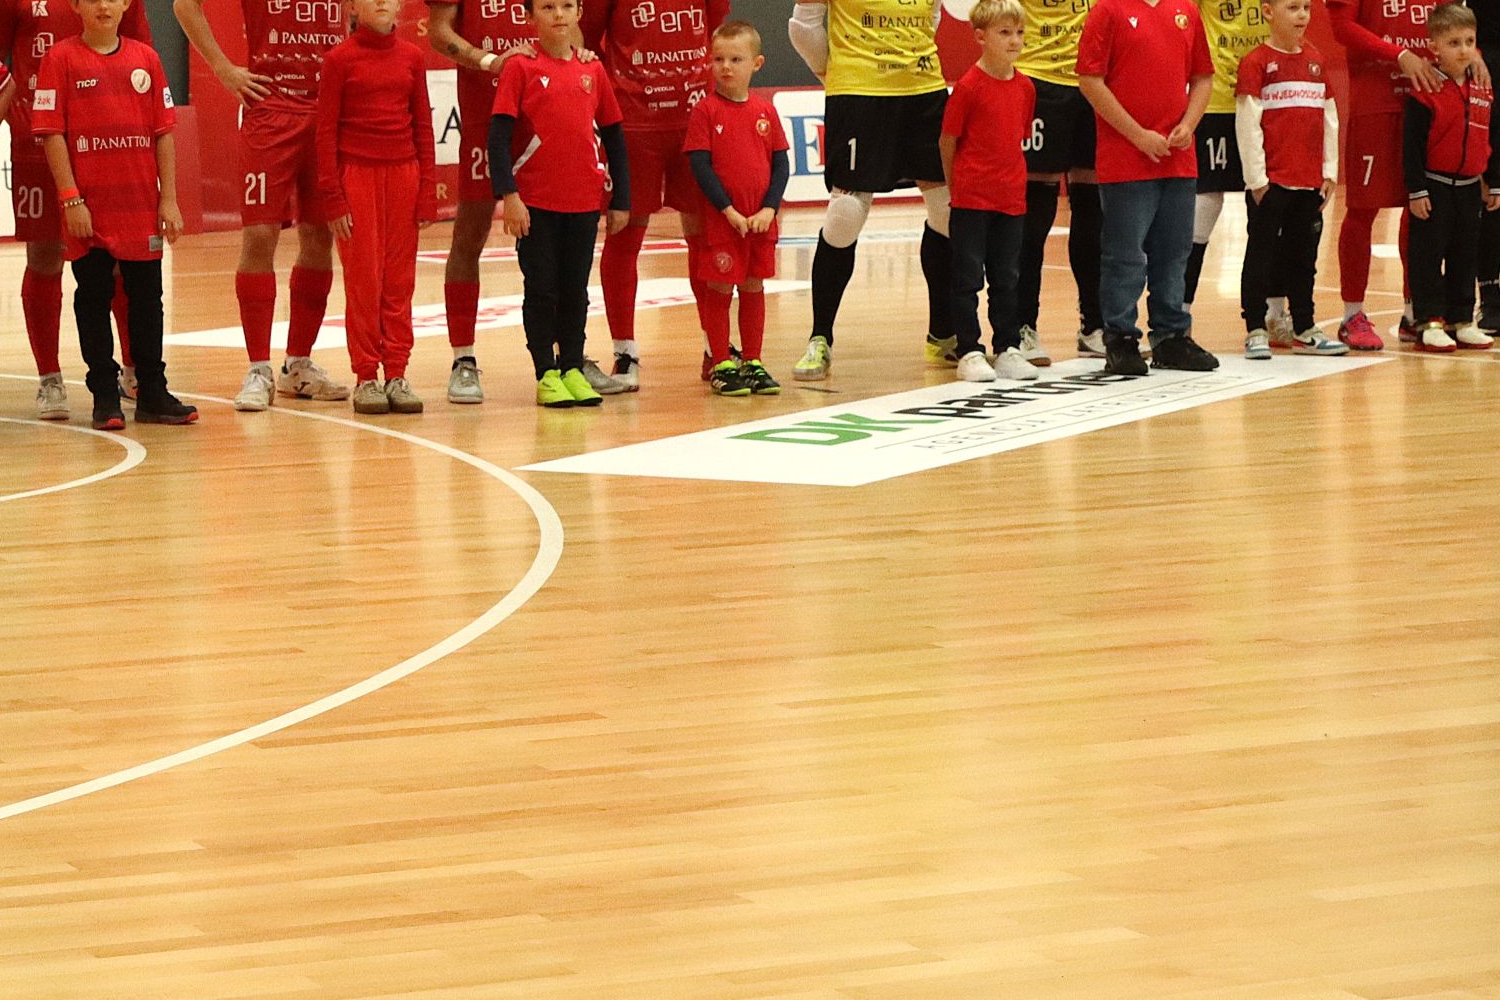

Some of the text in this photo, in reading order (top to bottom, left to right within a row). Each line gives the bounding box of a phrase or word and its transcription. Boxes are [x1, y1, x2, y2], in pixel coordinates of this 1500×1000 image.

[282, 31, 344, 45] PANATTON
[76, 79, 97, 89] TICO
[93, 135, 151, 150] PANATTON
[847, 137, 857, 171] 1
[1205, 136, 1227, 170] 14
[1362, 155, 1375, 186] 7
[17, 185, 44, 219] 20
[244, 172, 267, 205] 21
[725, 370, 1154, 446] DK partne
